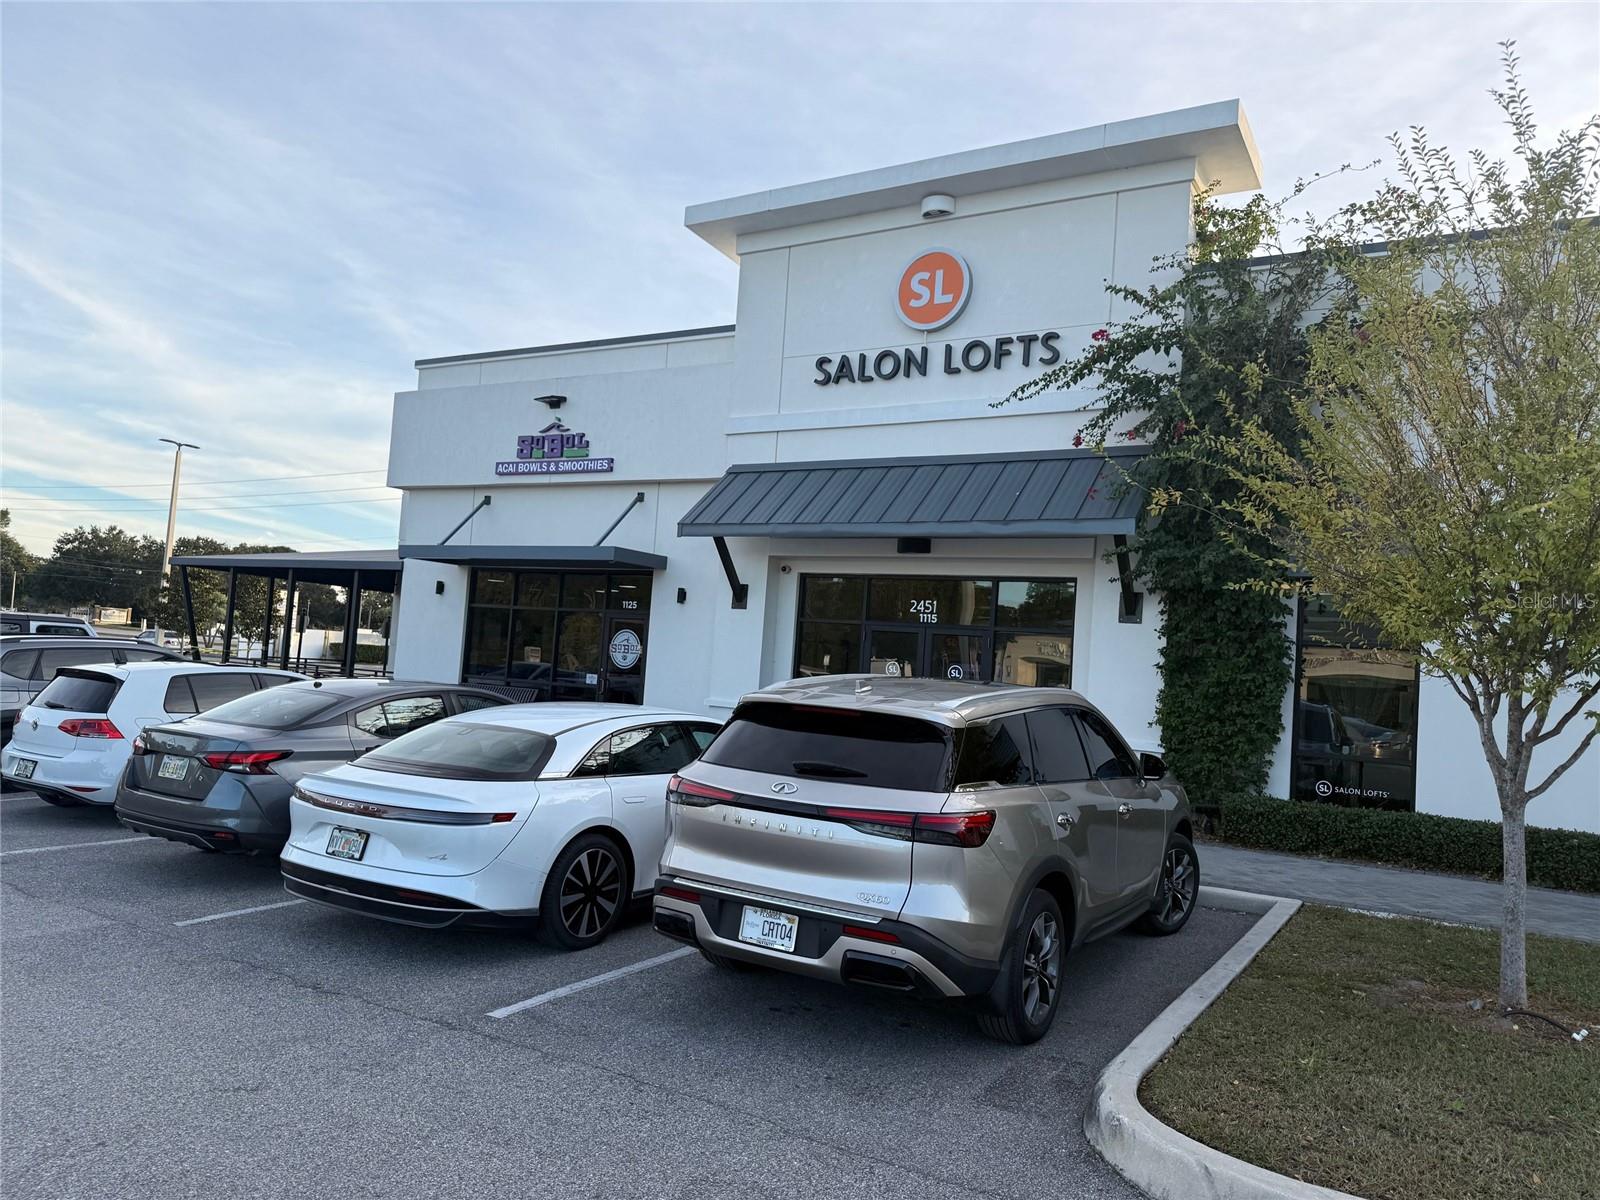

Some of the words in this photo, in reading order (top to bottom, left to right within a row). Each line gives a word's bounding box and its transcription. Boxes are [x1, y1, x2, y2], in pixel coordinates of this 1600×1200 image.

[909, 269, 954, 308] SL
[813, 346, 928, 386] SALON
[943, 331, 1061, 375] LOFTS
[497, 463, 516, 473] ACAI
[518, 462, 547, 473] BOWLS
[549, 462, 556, 471] &
[558, 460, 609, 471] SMOOTHIES
[622, 601, 637, 609] 1125
[909, 600, 937, 613] 2451
[919, 613, 938, 623] 1115
[1334, 786, 1360, 795] SALON
[1363, 789, 1388, 798] LOFTS
[324, 797, 378, 811] LUCID
[722, 813, 833, 839] INFINITI
[761, 920, 793, 942] CRT04
